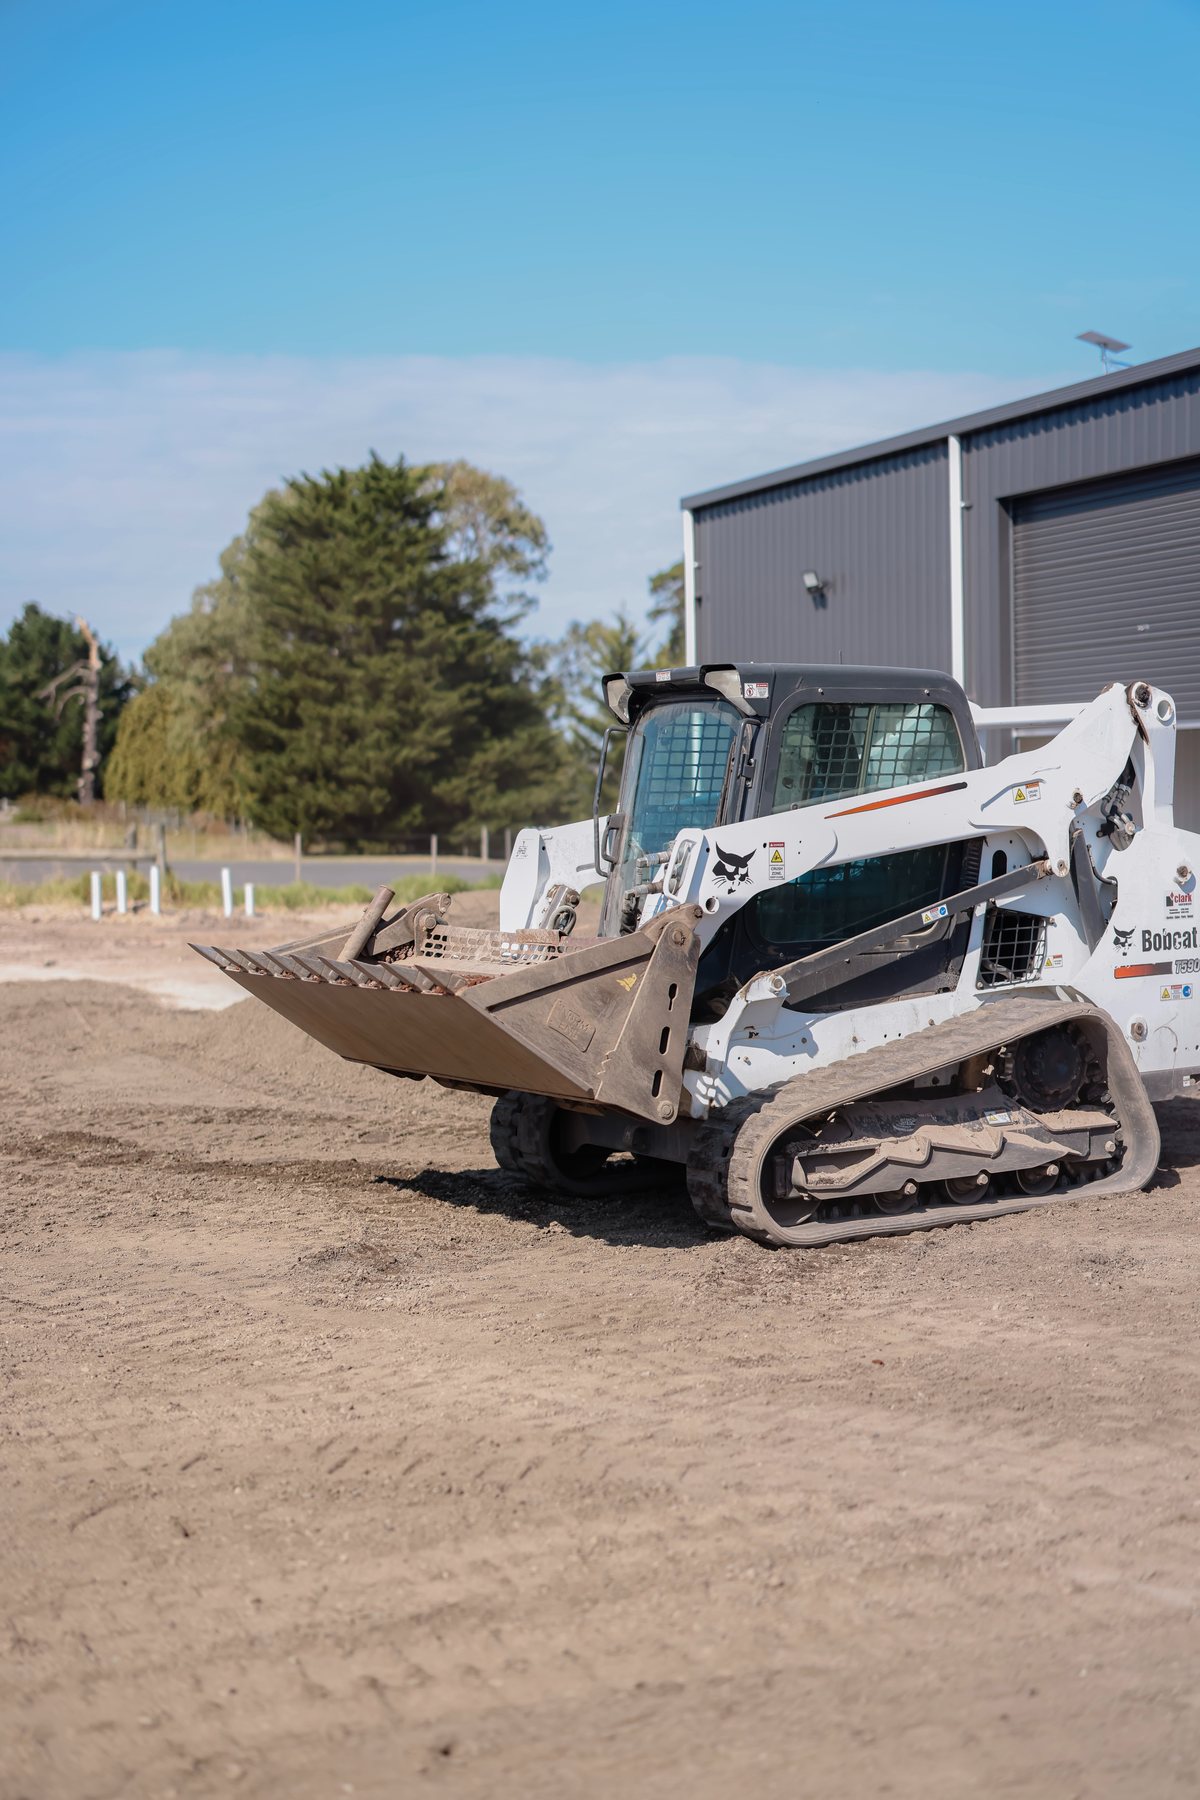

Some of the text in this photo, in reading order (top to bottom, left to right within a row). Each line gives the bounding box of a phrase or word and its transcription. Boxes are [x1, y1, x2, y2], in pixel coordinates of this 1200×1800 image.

[1174, 893, 1192, 903] clark
[1141, 927, 1198, 952] Bobcat
[1175, 958, 1200, 974] T590
